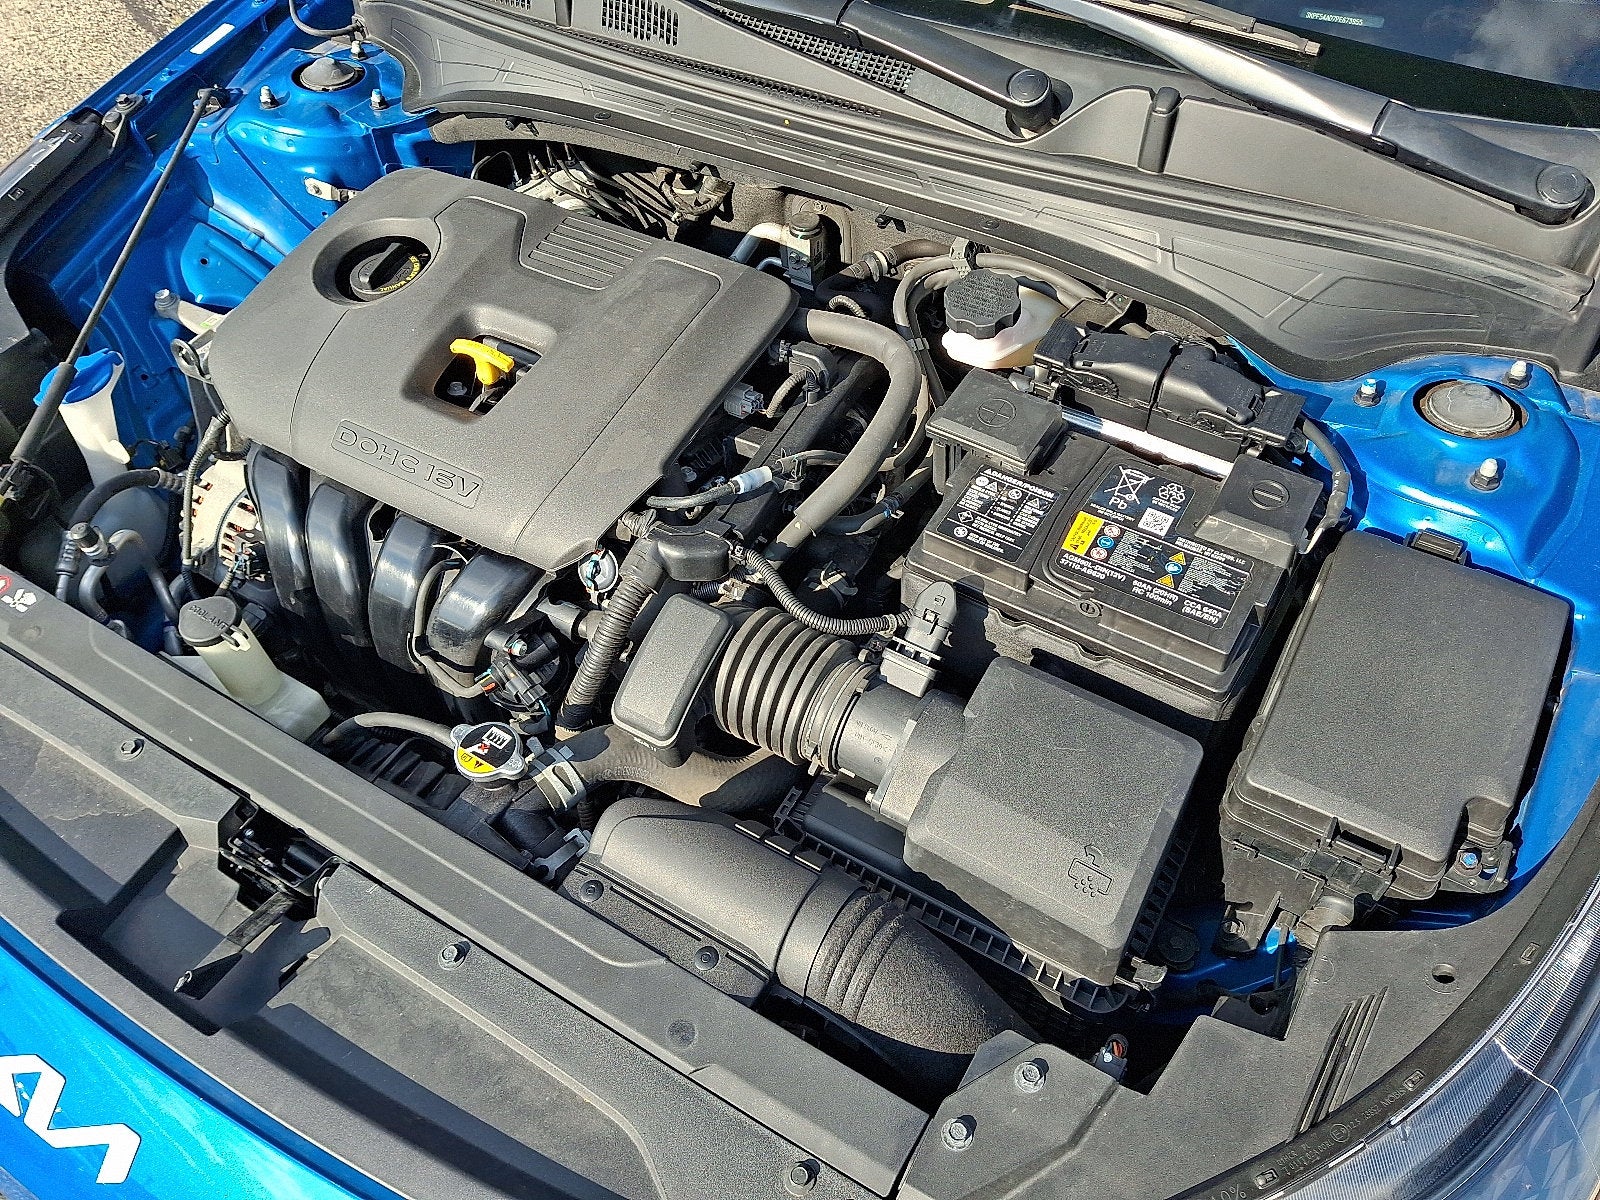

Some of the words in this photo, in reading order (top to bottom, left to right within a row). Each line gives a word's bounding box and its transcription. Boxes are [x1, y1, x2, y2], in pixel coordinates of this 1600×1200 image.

[335, 425, 420, 475] DOHC
[424, 463, 480, 498] 16V
[1109, 496, 1128, 510] Pb
[1132, 579, 1153, 592] 60Ah
[1131, 586, 1146, 595] RC
[1145, 591, 1173, 607] 100min
[1183, 599, 1202, 610] CCA
[187, 604, 230, 631] COOLANT
[1381, 1088, 1408, 1107] MOBIS
